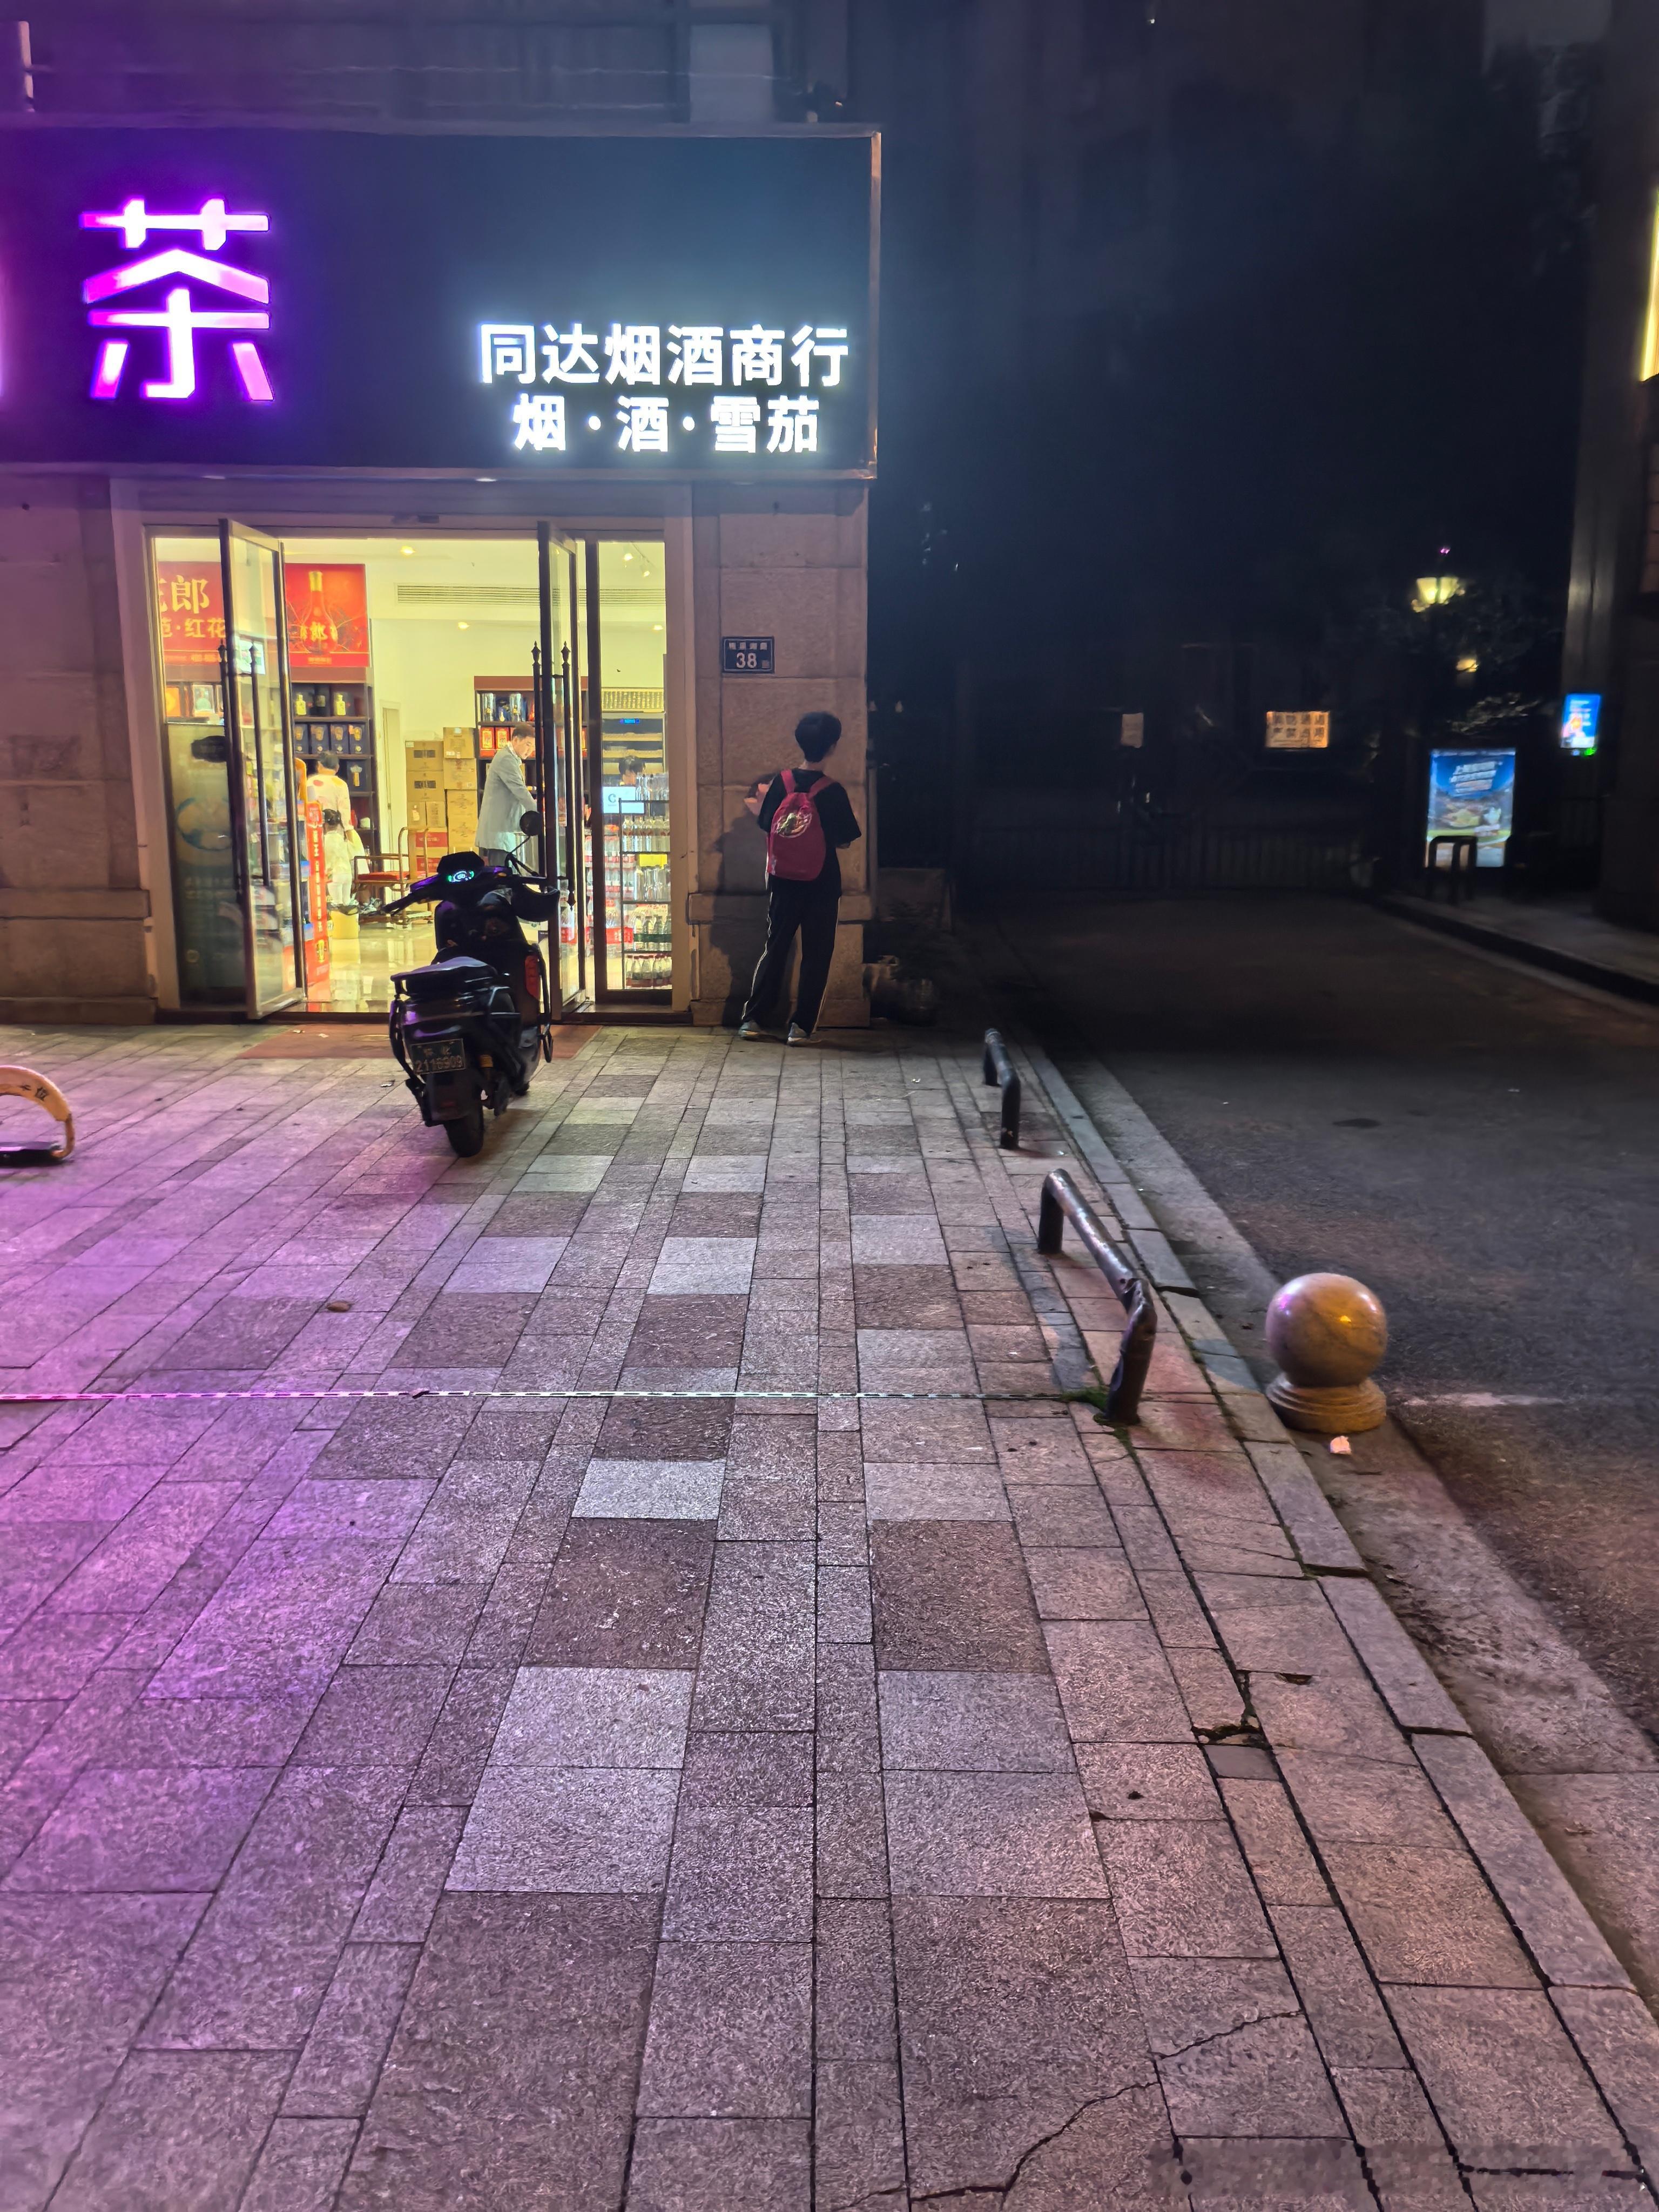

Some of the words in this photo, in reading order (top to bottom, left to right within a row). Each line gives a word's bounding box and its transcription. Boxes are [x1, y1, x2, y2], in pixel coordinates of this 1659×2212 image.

[80, 197, 274, 401] 茶
[479, 323, 849, 387] 同达烟酒商行
[158, 575, 210, 613] 郎
[736, 652, 757, 668] 38
